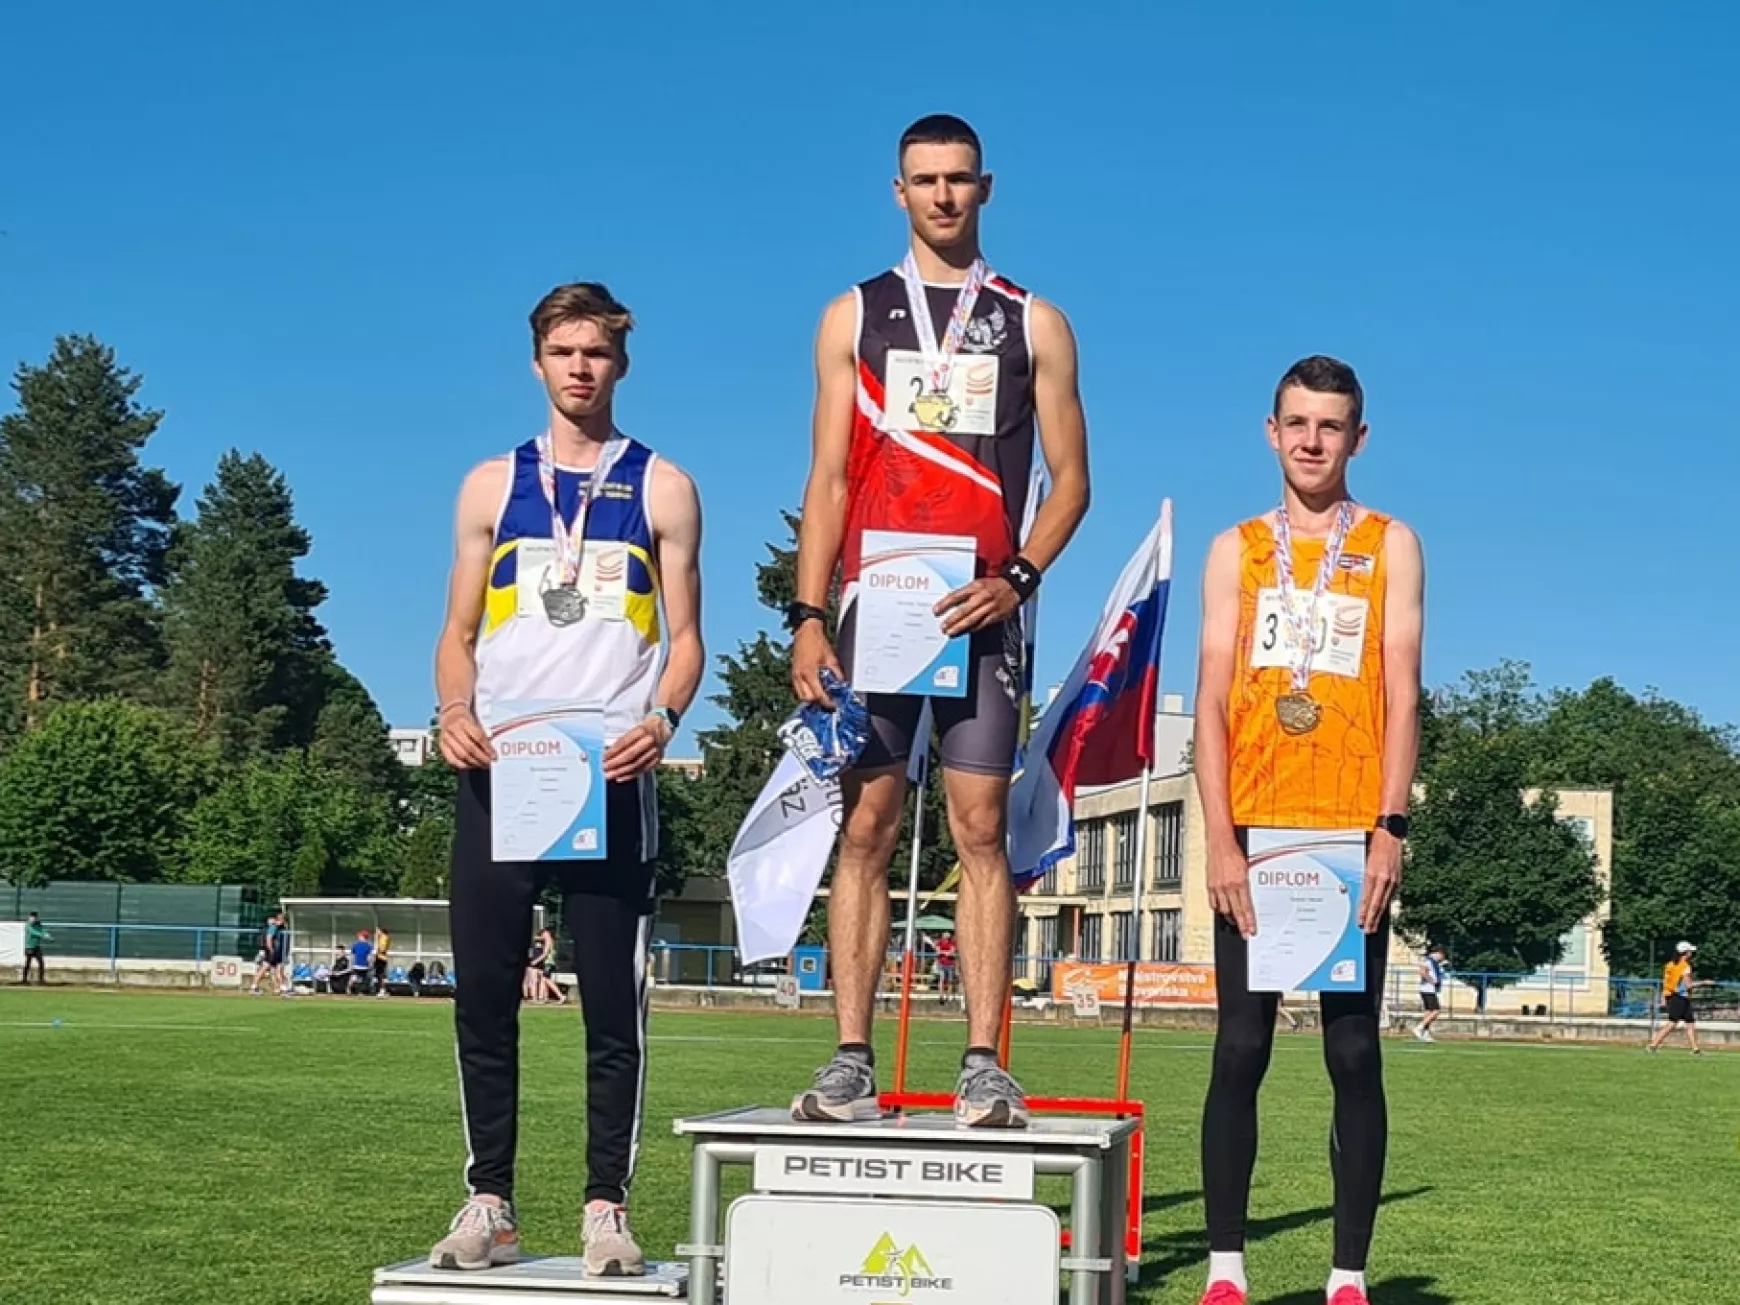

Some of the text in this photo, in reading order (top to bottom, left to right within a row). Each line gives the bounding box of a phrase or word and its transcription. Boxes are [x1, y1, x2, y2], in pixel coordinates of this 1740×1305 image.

[868, 573, 930, 589] DIPLOM
[500, 741, 561, 755] DIPLOM
[1258, 871, 1319, 885] DIPLOM
[216, 961, 237, 976] 50
[780, 981, 797, 996] 40
[784, 1156, 1004, 1183] PETIST BIKE
[839, 1274, 954, 1290] PETIST BIKE
